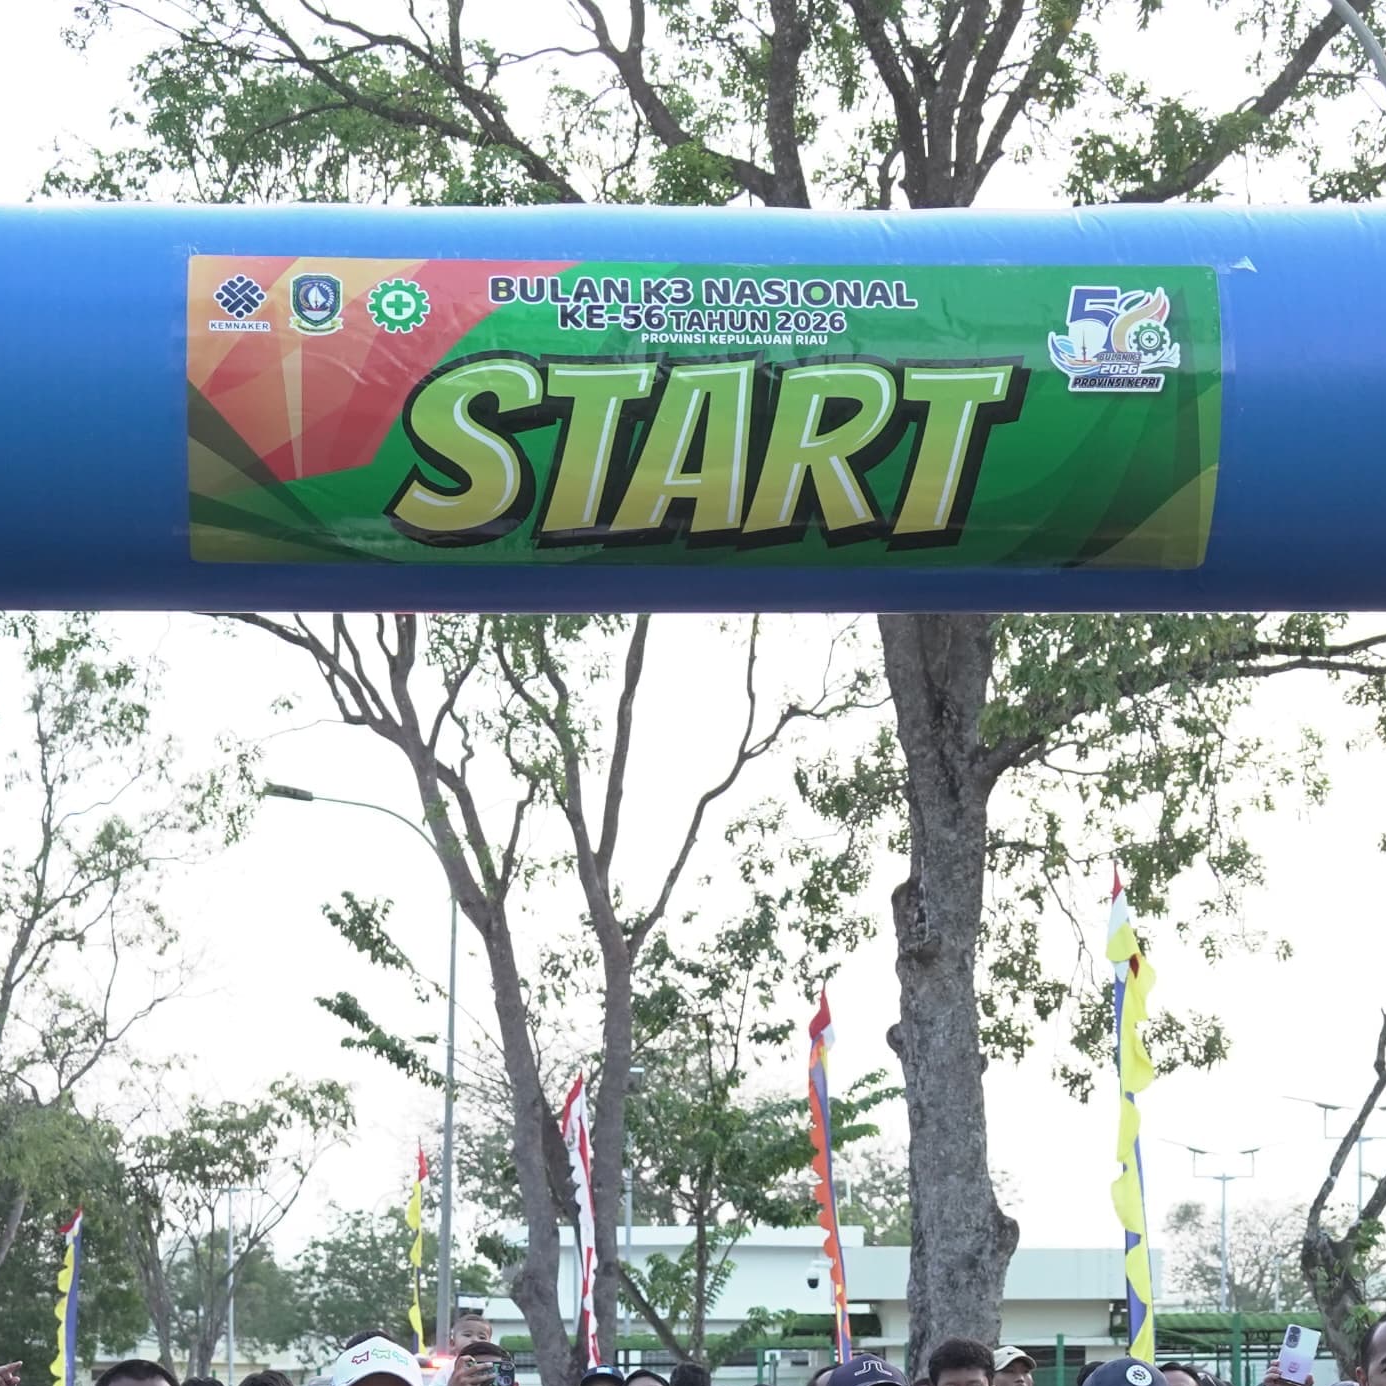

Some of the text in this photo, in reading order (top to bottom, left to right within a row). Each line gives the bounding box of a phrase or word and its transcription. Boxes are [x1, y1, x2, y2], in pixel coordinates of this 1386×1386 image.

[489, 276, 918, 310] BULAN K3 NASIONAL
[558, 304, 847, 333] KE-56 TAHUN 2026
[210, 322, 269, 331] KEMNAKER
[641, 332, 829, 346] PROVINSI KEPULAUAN RIAU
[1099, 362, 1139, 375] 2026
[1072, 377, 1161, 388] PROVINSI KEPRI
[388, 354, 1021, 543] START
